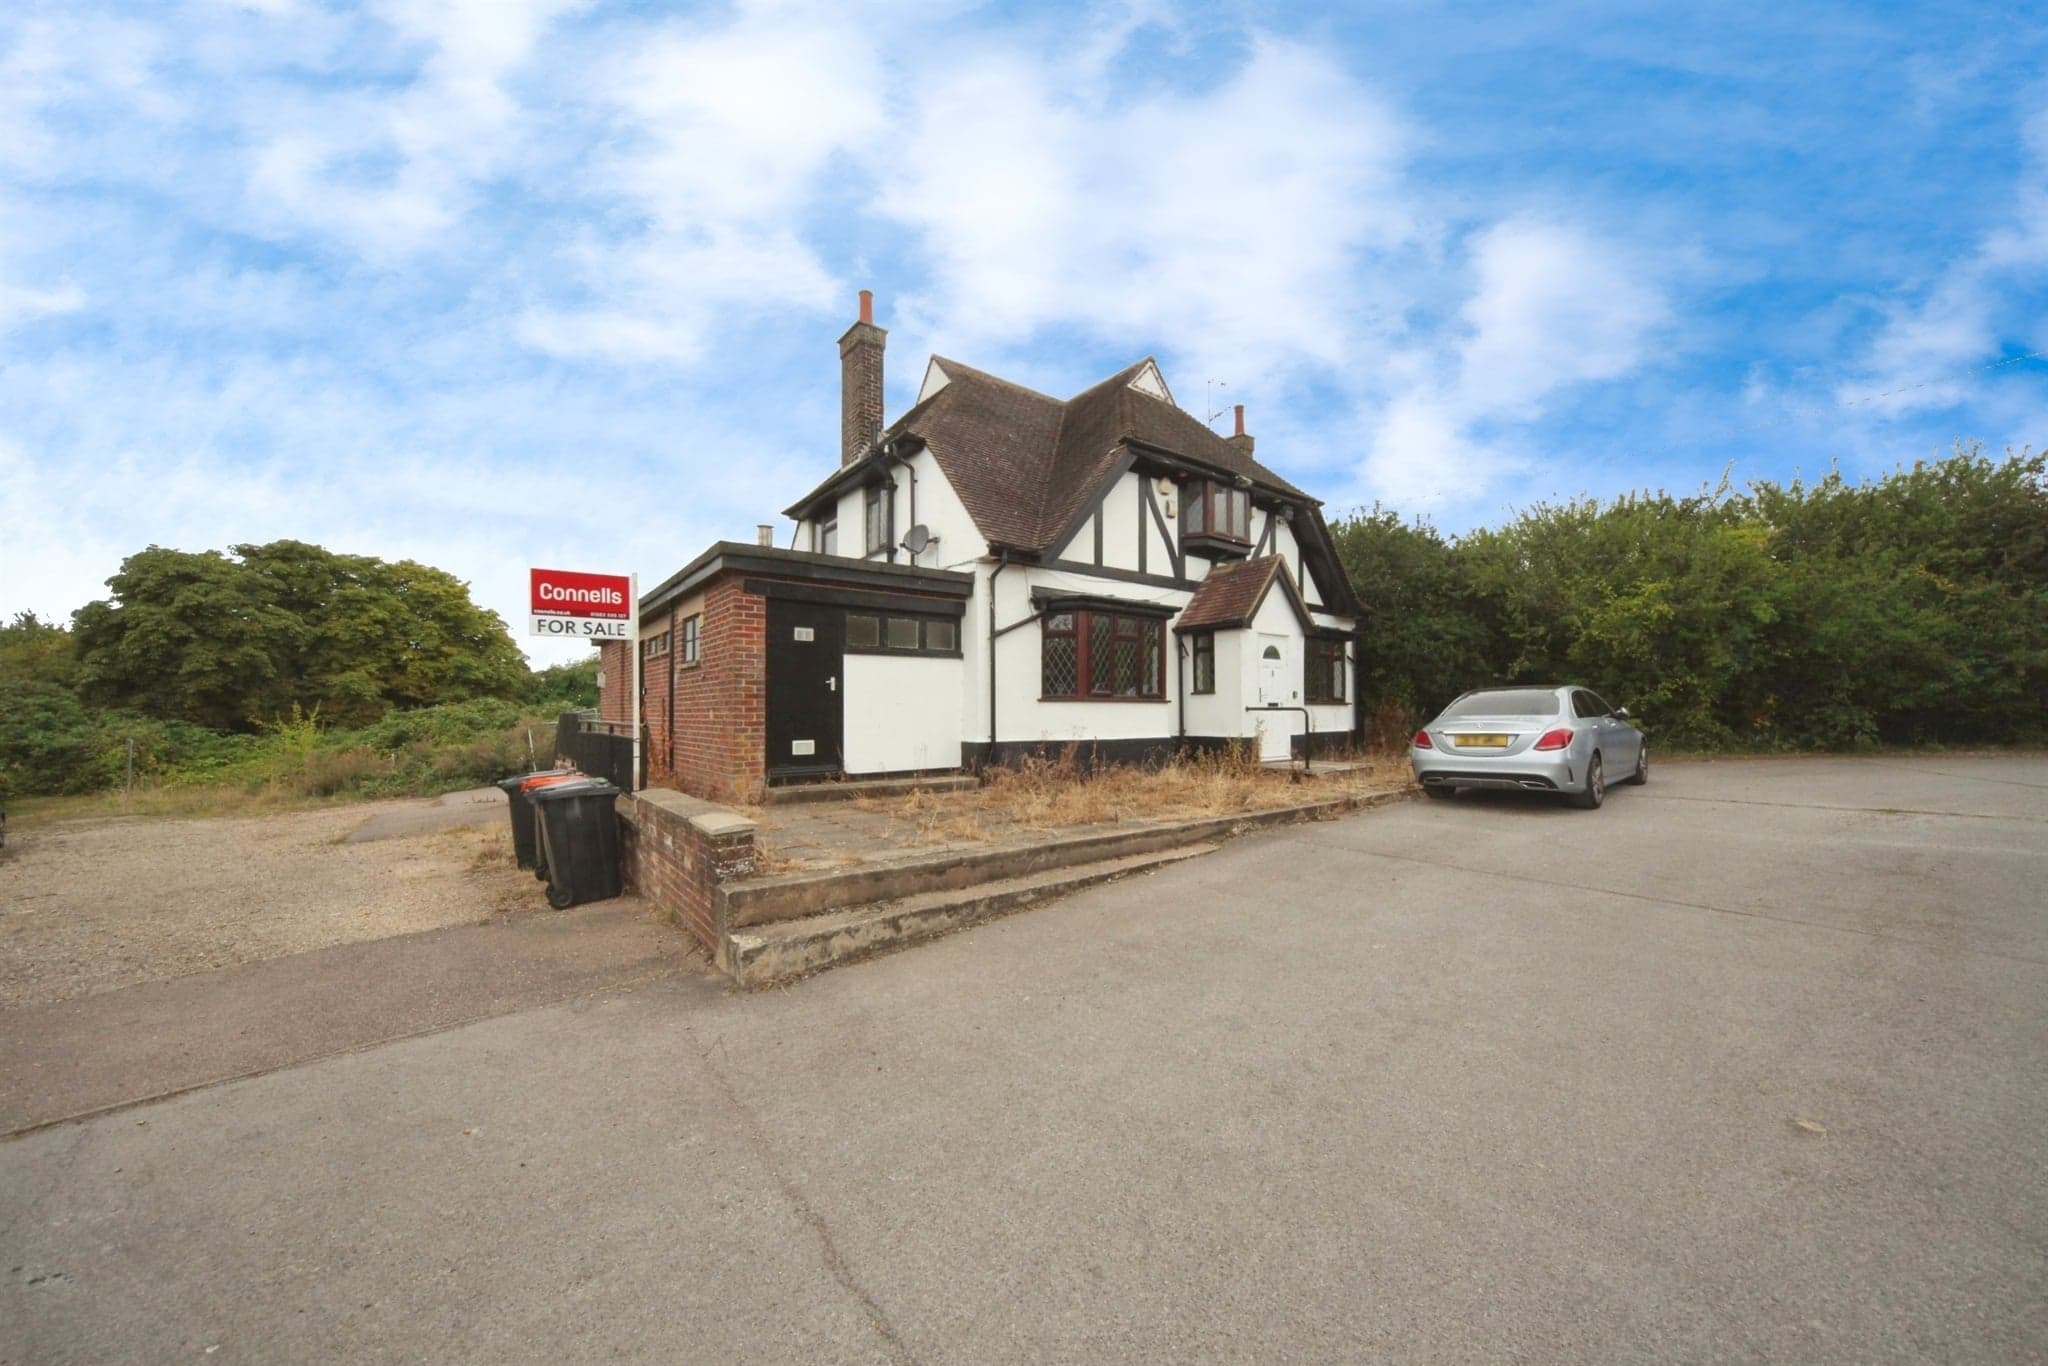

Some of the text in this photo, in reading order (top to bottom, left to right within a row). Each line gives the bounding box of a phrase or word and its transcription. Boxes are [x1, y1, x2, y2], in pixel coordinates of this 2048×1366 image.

[539, 582, 622, 605] Connells
[537, 619, 625, 636] FOR SALE
